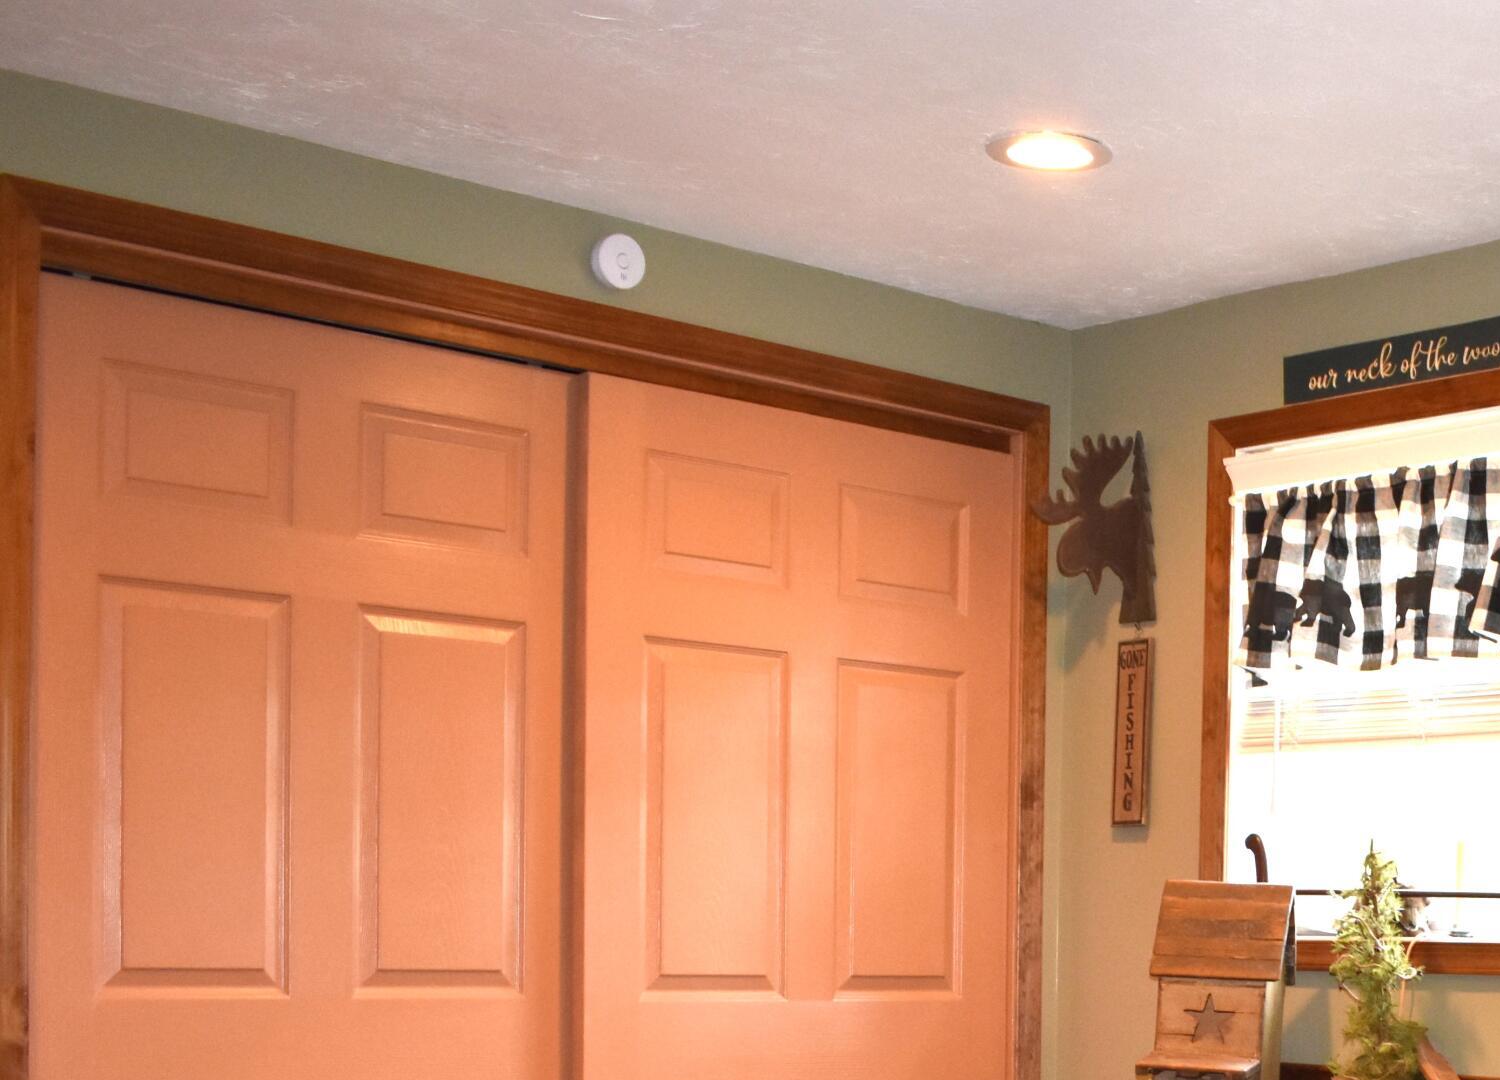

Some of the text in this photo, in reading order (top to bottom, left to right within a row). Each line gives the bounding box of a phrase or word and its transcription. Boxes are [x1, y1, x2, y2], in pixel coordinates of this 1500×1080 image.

[1308, 368, 1338, 391] our
[1344, 342, 1398, 384] neck
[1400, 340, 1422, 380] of
[1422, 335, 1457, 372] the
[1120, 649, 1146, 669] GONE
[1122, 672, 1137, 812] FISHING
